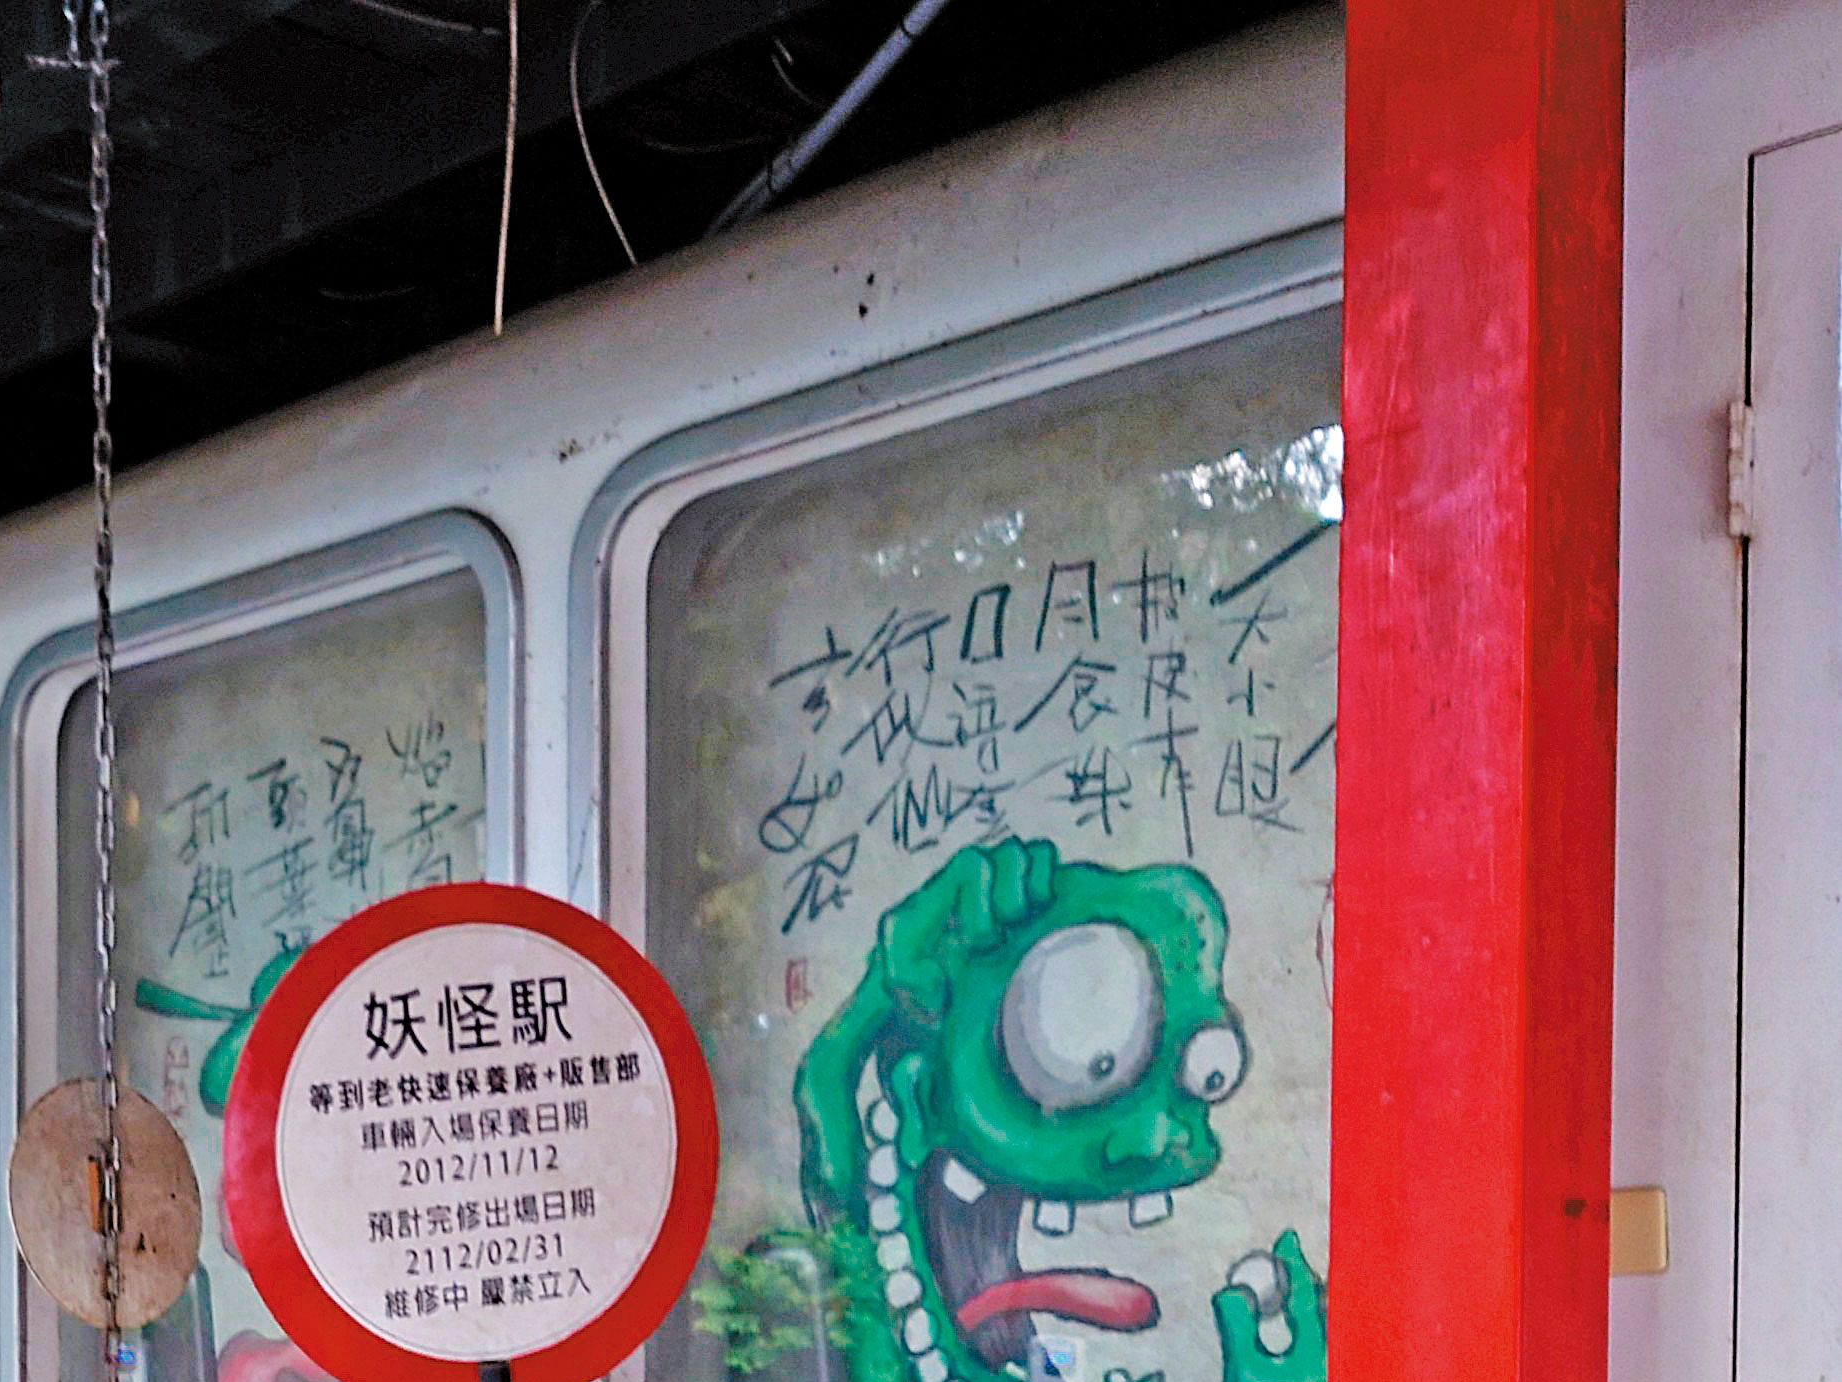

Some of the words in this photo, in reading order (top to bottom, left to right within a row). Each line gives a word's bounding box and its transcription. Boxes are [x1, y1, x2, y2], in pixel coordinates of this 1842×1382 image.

[363, 976, 573, 1060] 妖怪駅
[361, 1100, 590, 1153] 車輛入場保養日期
[398, 1145, 560, 1187] 2012/11/12
[369, 1187, 597, 1243] 預計完修出場日期
[406, 1233, 565, 1276] 2112/02/31
[384, 1282, 469, 1320] 維修中
